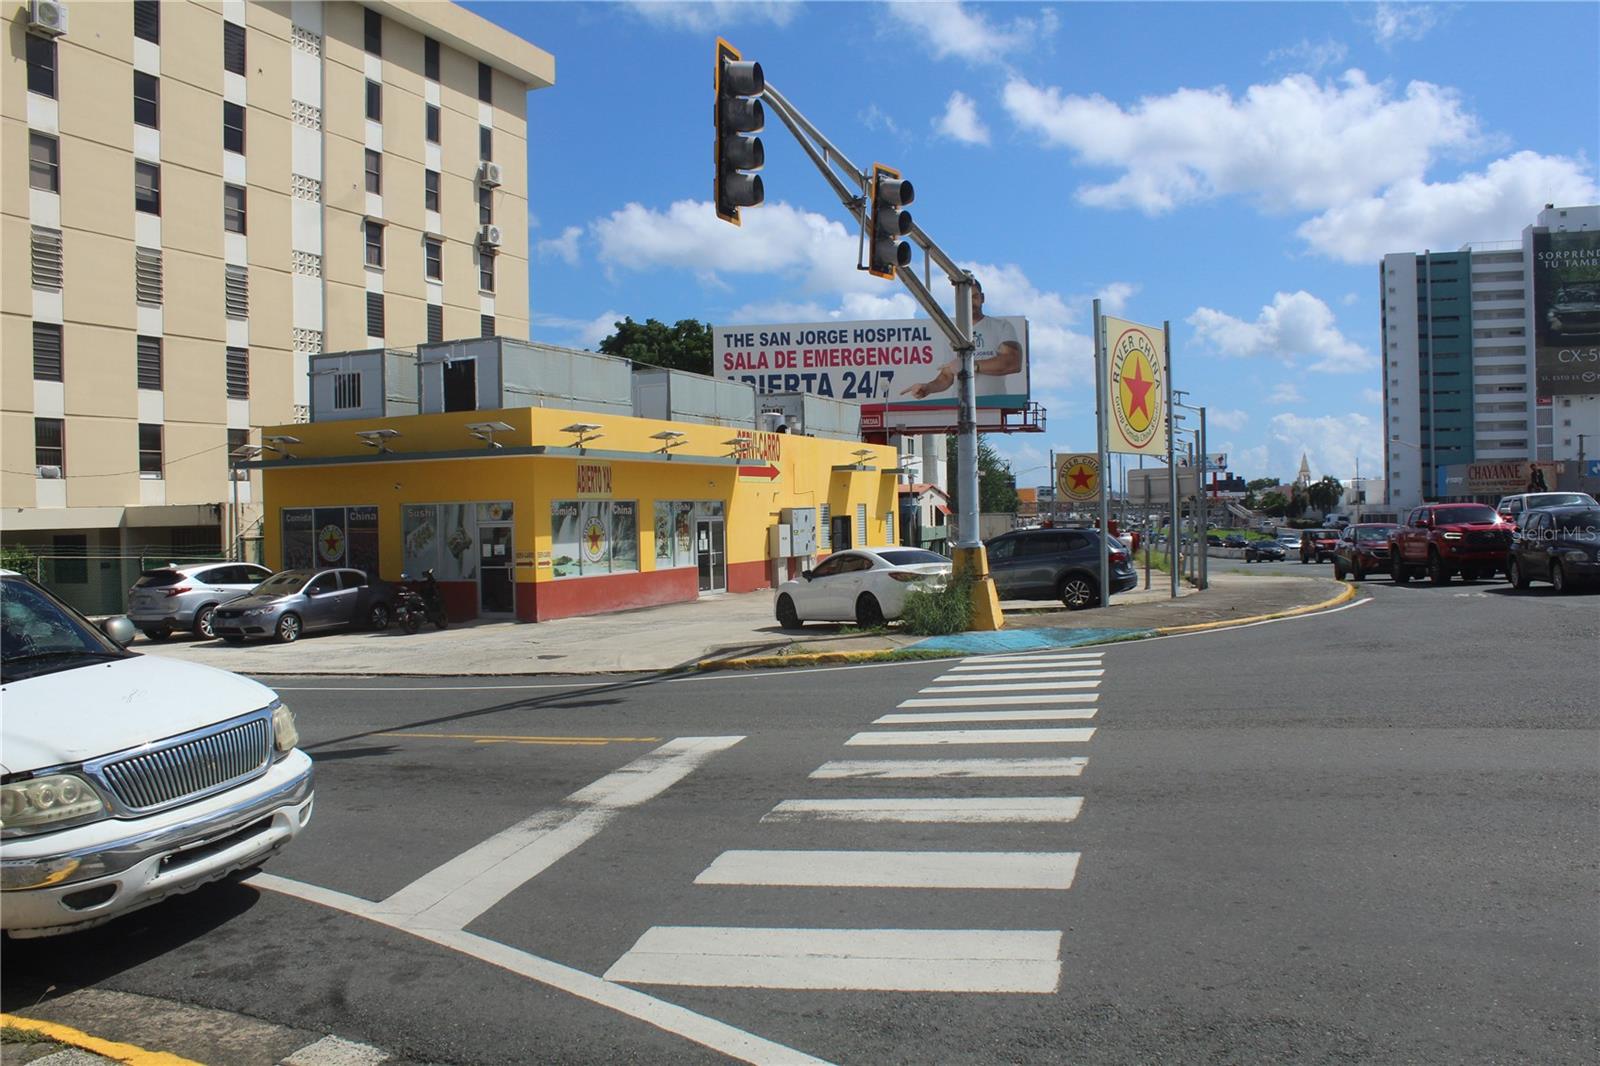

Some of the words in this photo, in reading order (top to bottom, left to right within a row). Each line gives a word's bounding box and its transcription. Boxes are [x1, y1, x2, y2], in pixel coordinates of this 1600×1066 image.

[723, 333, 754, 348] THE
[759, 331, 791, 346] SAN
[796, 329, 848, 345] JORGE
[853, 327, 932, 343] HOSPITAL
[723, 351, 769, 371] SALA
[774, 350, 797, 369] DE
[803, 345, 933, 368] EMERGENCIAS
[1113, 335, 1134, 383] RIVER
[1139, 336, 1160, 389] CHINA
[842, 371, 894, 399] 24/7
[1468, 463, 1521, 480] CHAYANNE
[350, 511, 377, 521] China
